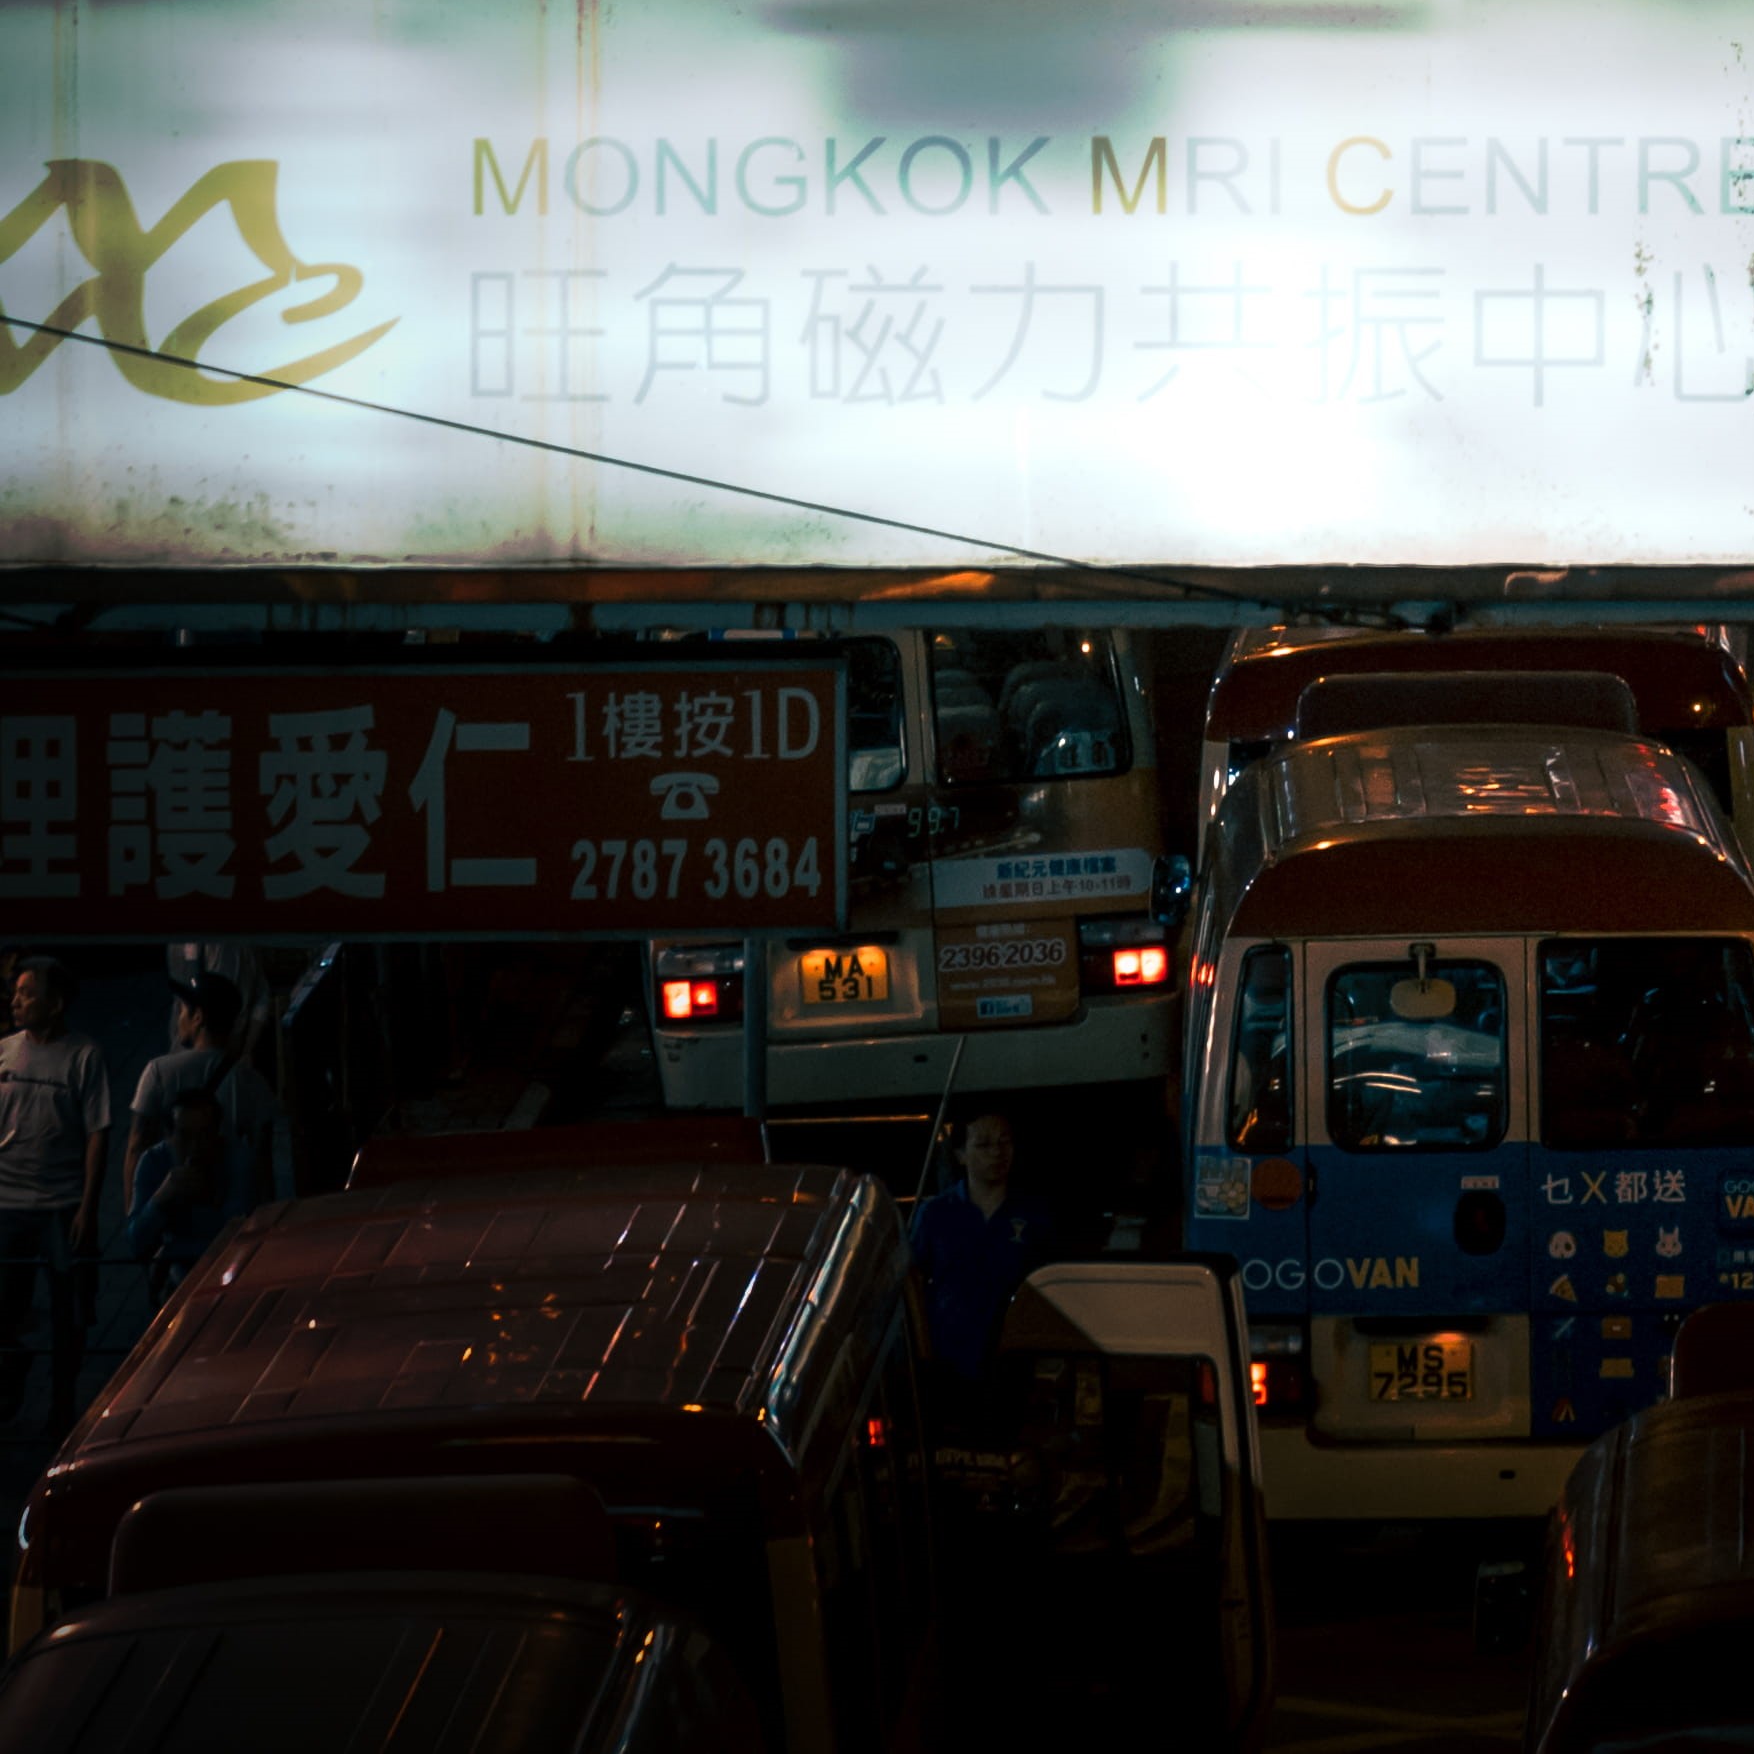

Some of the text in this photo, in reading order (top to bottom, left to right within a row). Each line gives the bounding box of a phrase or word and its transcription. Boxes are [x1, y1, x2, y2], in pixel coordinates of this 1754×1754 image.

[471, 136, 1050, 218] MONGKOK
[1090, 136, 1283, 218] MRI
[570, 837, 824, 902] 2787 3684
[824, 956, 862, 979] MA
[940, 940, 1066, 970] 2396 2036
[819, 978, 875, 1001] 531
[1243, 1256, 1420, 1290] OGOVAN
[1398, 1346, 1446, 1371] MS
[1375, 1371, 1468, 1396] 7295
